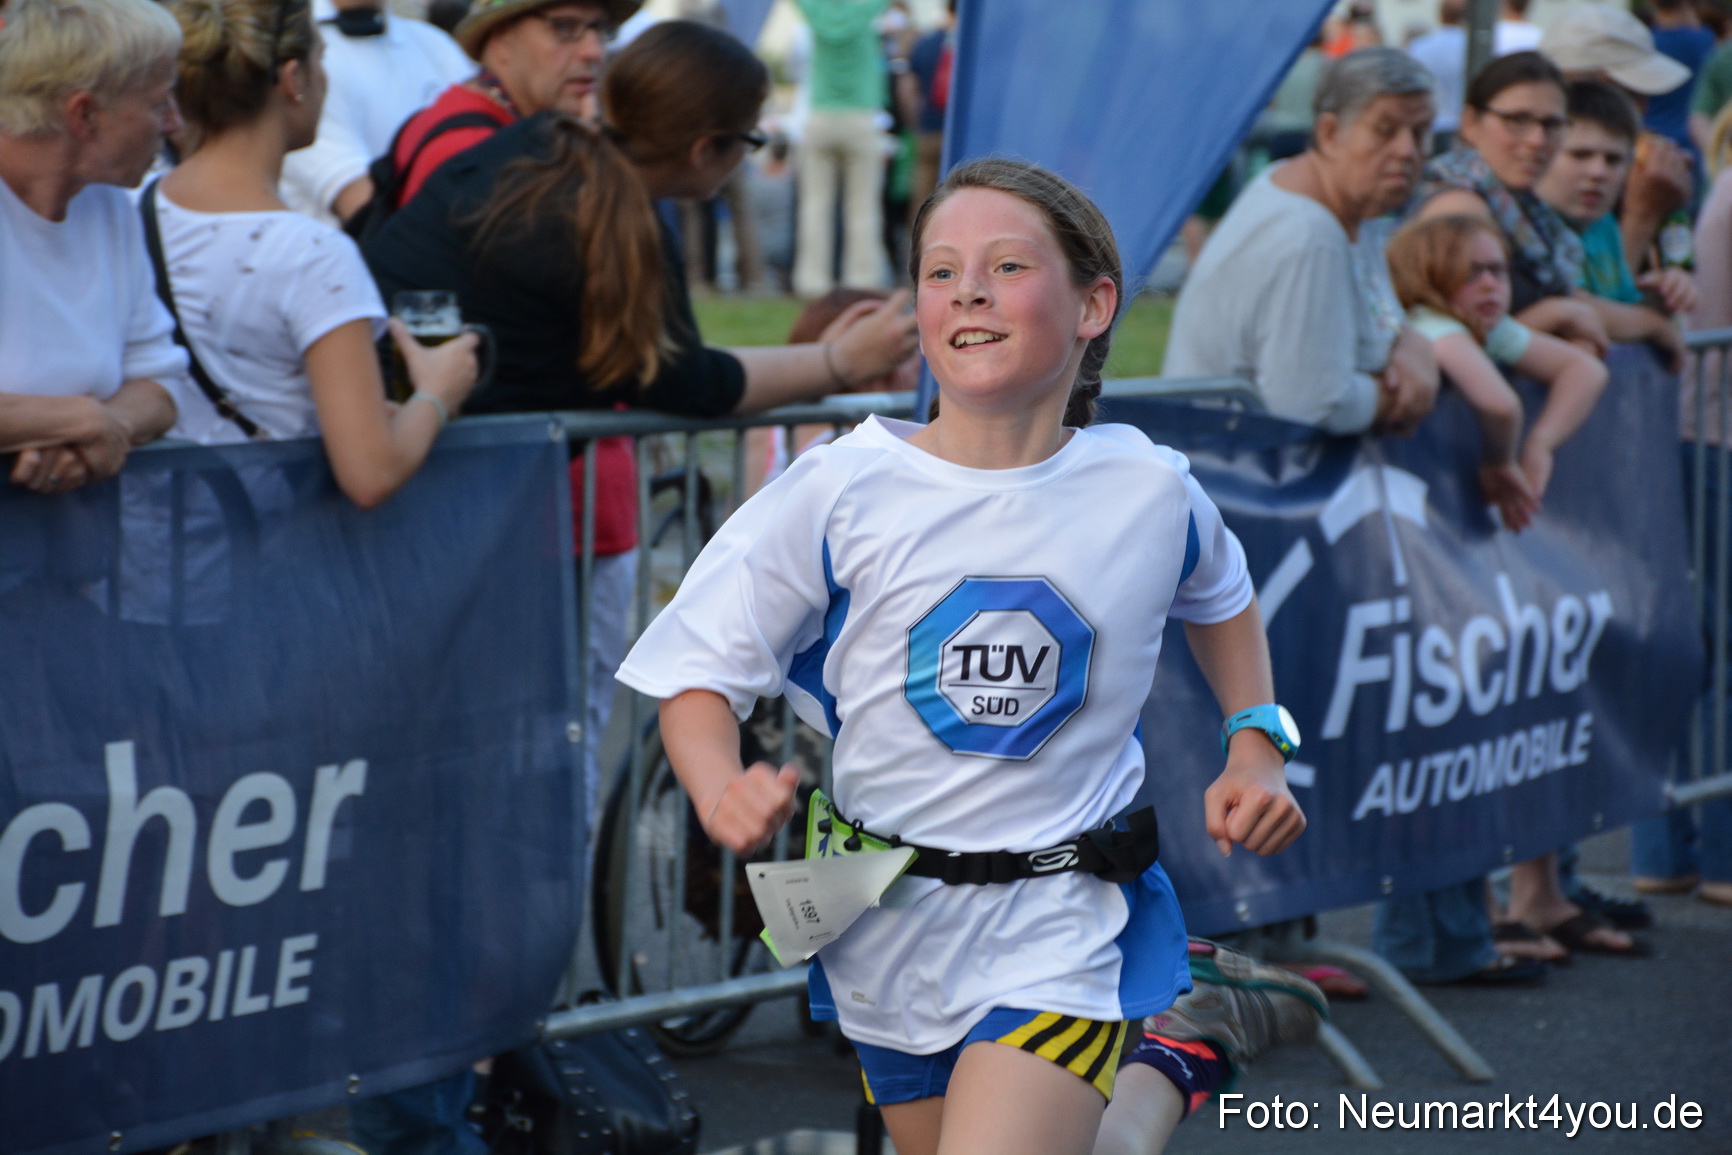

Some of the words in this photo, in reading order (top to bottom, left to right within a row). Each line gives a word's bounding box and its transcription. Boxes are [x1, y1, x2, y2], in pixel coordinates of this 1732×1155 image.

[952, 644, 1051, 683] TÜV
[1321, 572, 1613, 740] Fischer
[971, 695, 1020, 717] SÜD
[1352, 712, 1593, 821] AUTOMOBILE
[799, 898, 821, 924] 1597
